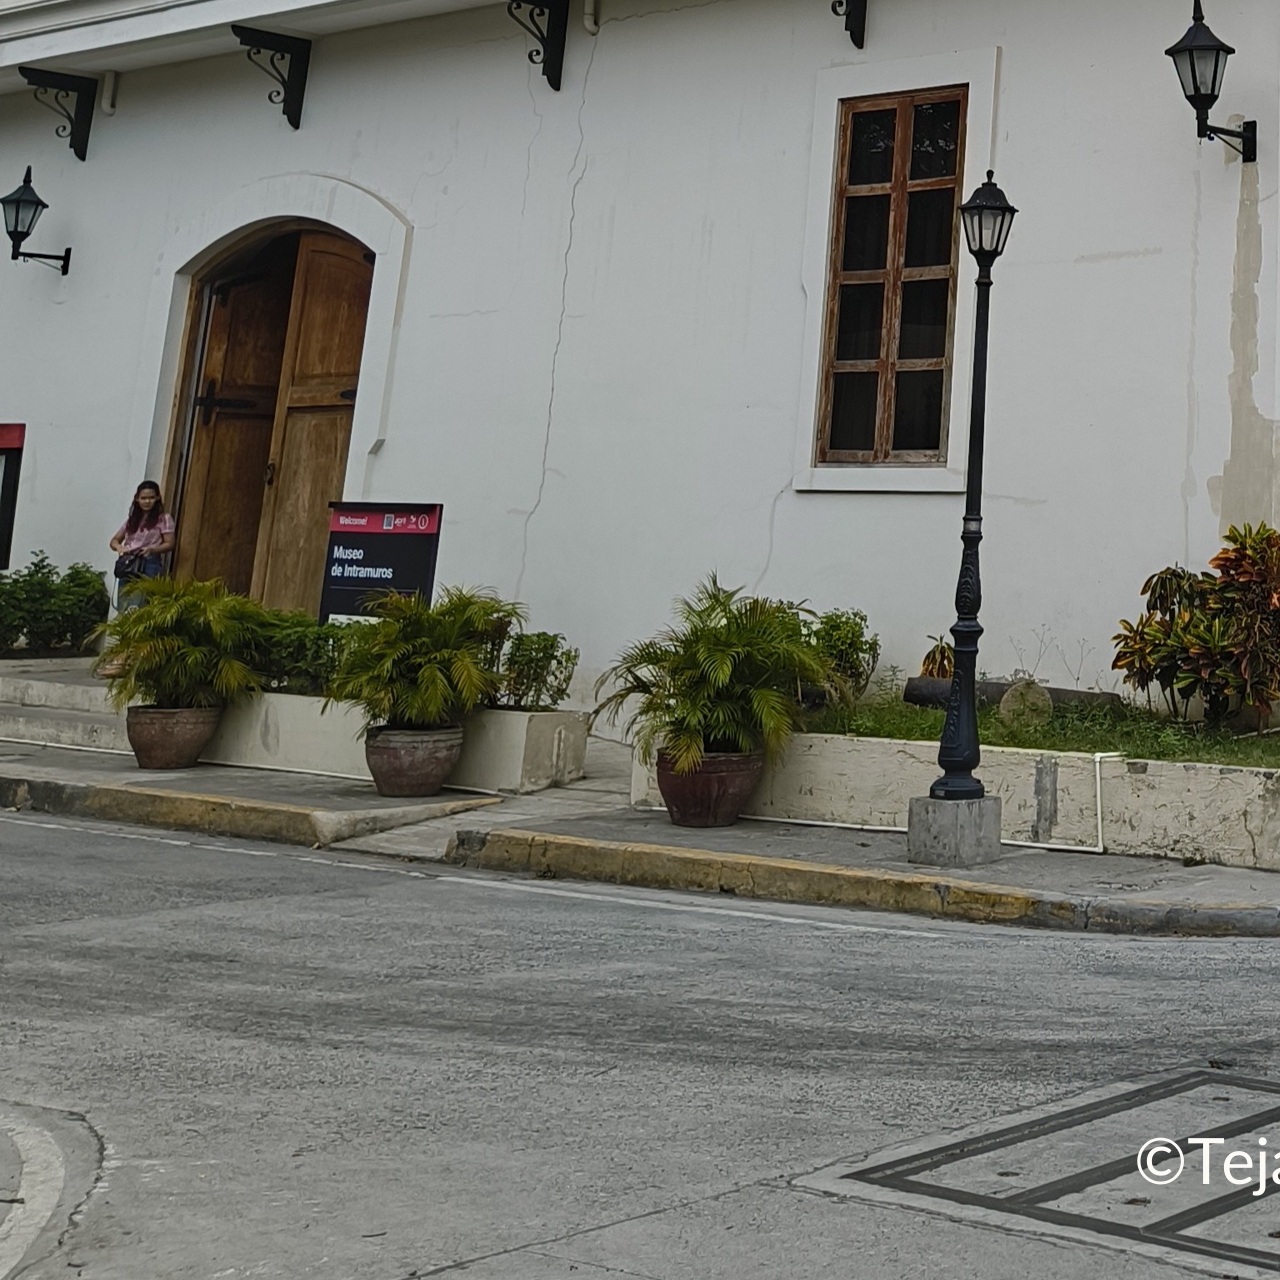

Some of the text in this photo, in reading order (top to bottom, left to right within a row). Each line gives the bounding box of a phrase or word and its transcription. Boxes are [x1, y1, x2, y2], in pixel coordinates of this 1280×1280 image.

[333, 545, 364, 560] Museo
[331, 563, 393, 579] de Intramuros
